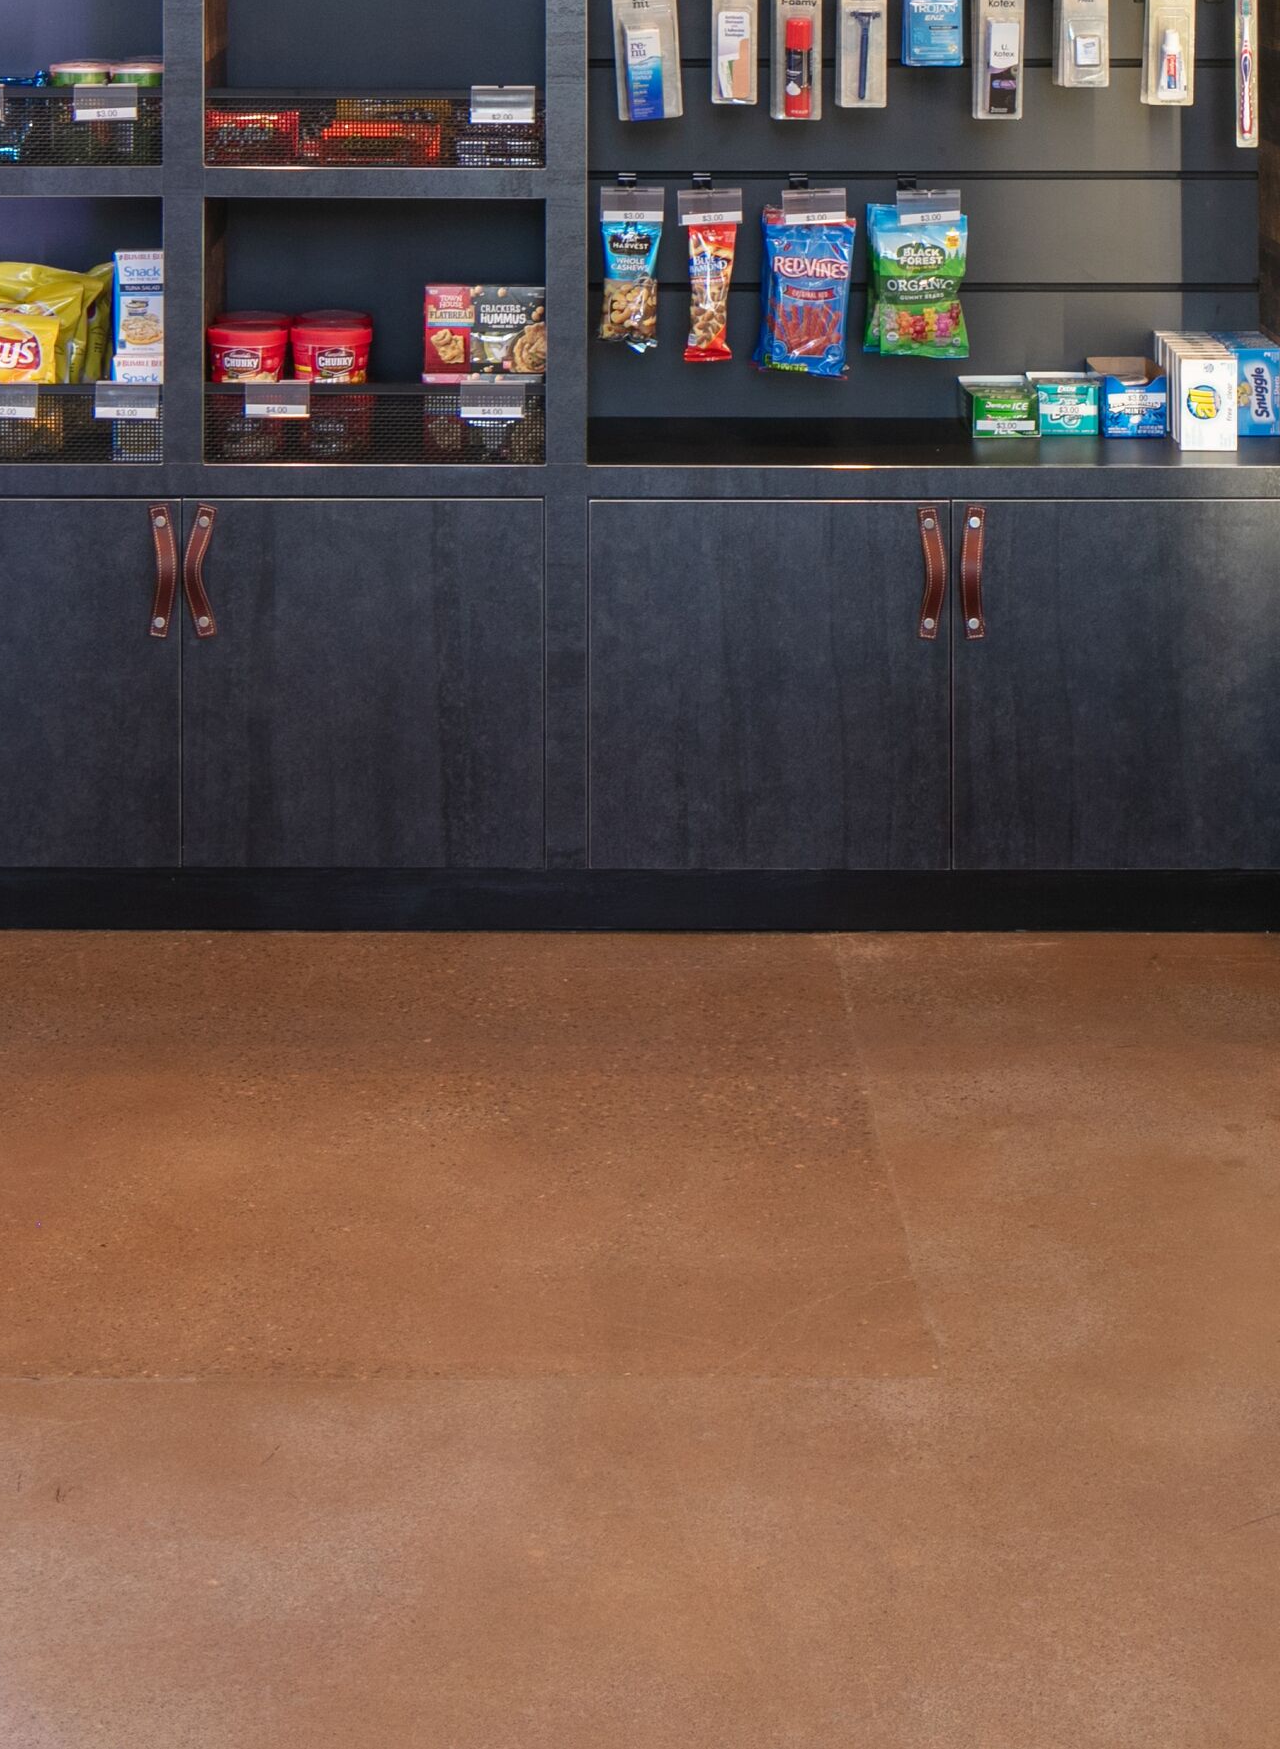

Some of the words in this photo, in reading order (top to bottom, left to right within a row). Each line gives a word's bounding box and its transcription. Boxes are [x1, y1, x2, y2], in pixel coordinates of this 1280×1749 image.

[912, 4, 956, 13] TROJAN
[96, 109, 118, 117] $3.00
[492, 113, 513, 121] $2.00
[623, 212, 645, 220] $3.00
[702, 213, 724, 222] $3.00
[806, 214, 827, 222] $3.00
[920, 213, 941, 222] $3.00
[613, 242, 649, 250] HARVEST
[903, 248, 940, 256] BLACK
[615, 257, 645, 265] WHOLE
[900, 256, 943, 265] FOREST
[124, 265, 160, 278] Snack
[887, 277, 954, 292] ORGANIC
[429, 311, 474, 319] FLATBREAD
[480, 313, 527, 324] HUMMUS
[224, 356, 259, 368] CHUNKY
[318, 355, 354, 367] CHUNKY
[1251, 367, 1270, 418] Snuggle
[1012, 402, 1029, 410] ICE
[1189, 388, 1217, 419] all
[115, 409, 137, 417] $3.00
[265, 406, 287, 414] $4.00
[481, 408, 503, 416] $4.00
